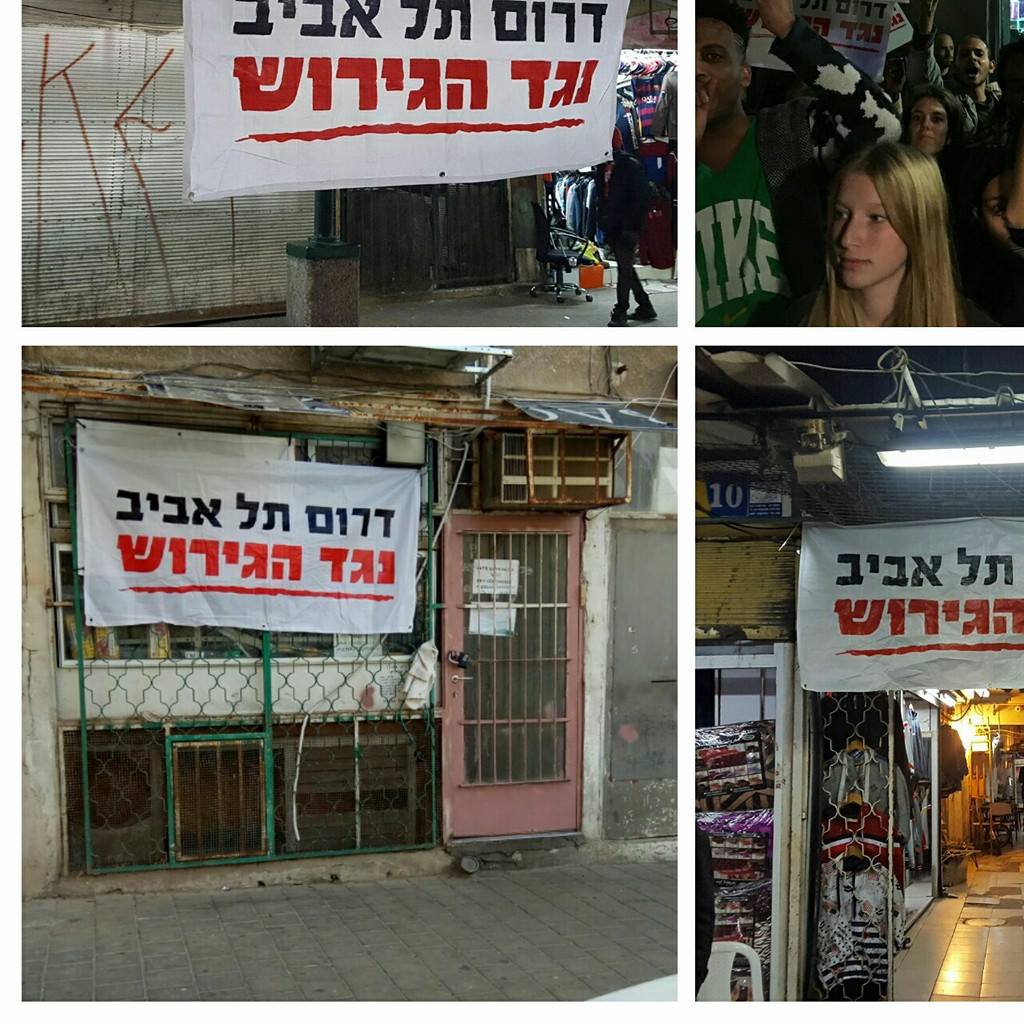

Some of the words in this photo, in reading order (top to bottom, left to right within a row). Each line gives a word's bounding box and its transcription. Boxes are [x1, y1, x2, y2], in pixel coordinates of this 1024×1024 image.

[491, 0, 608, 42] דרום
[840, 21, 885, 44] נגד
[234, 57, 488, 112] הגירוש
[116, 490, 221, 527] אביב
[236, 493, 290, 532] תל
[710, 483, 743, 508] 10
[305, 506, 395, 537] דרום
[118, 535, 302, 581] הגירוש
[320, 547, 395, 584] נגד
[836, 554, 943, 587] אביב
[957, 547, 1013, 586] תל
